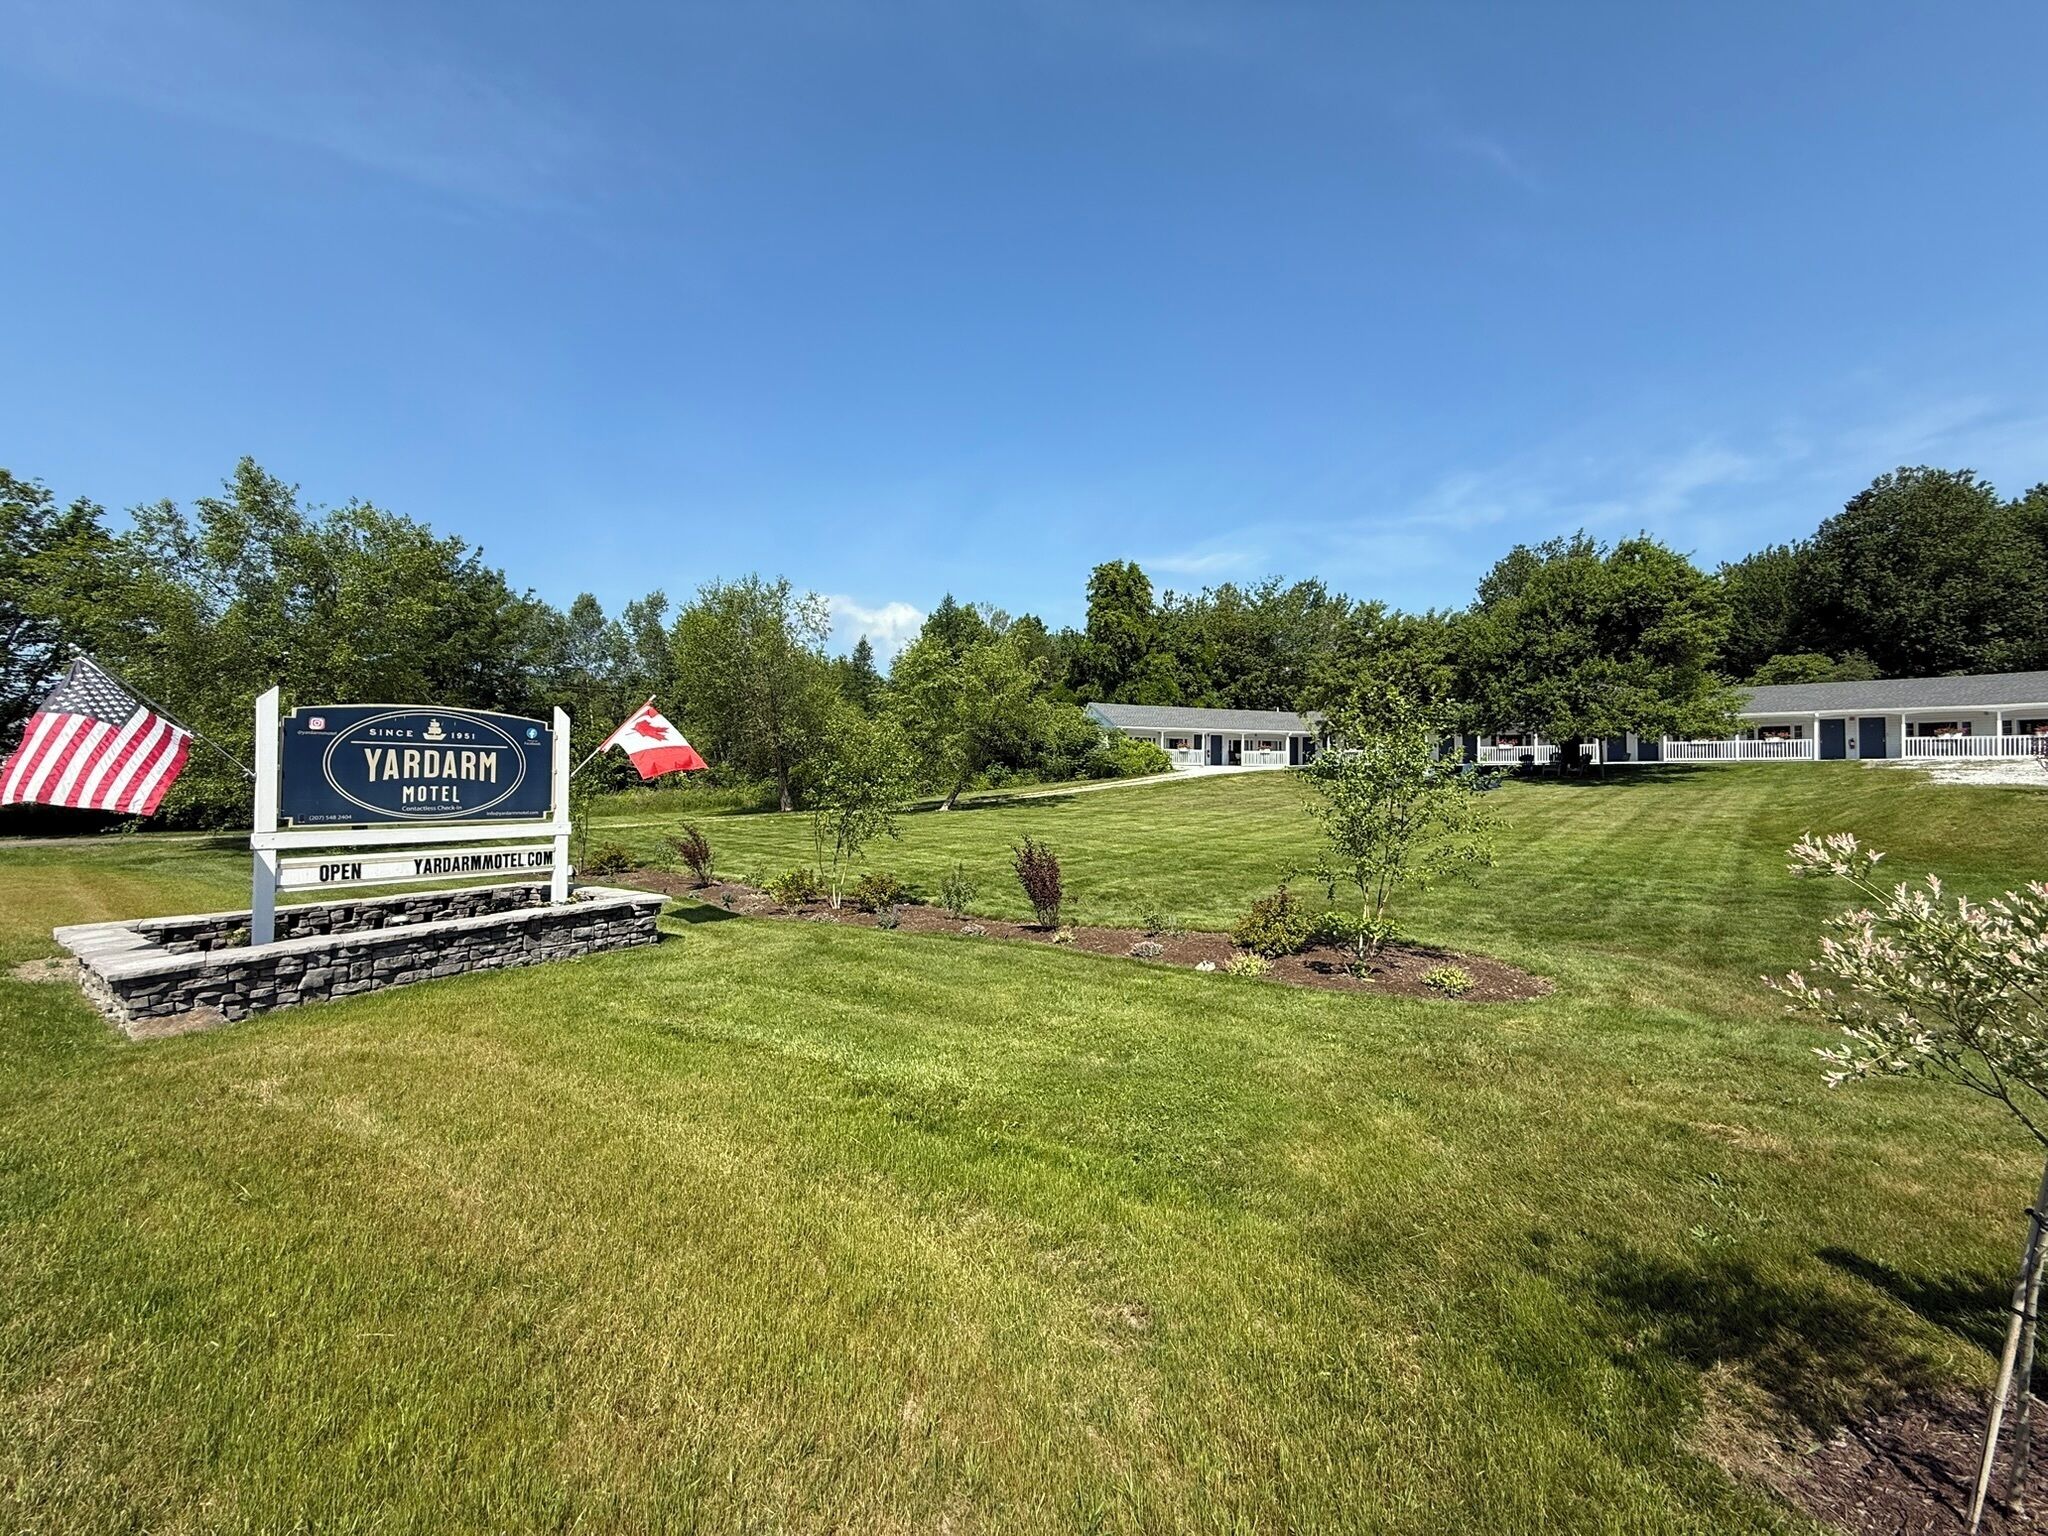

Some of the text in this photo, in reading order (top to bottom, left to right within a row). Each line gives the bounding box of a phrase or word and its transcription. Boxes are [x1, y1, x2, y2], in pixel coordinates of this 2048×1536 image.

[369, 728, 476, 740] SINCE 1951
[364, 748, 497, 784] YARDARM
[402, 785, 460, 804] MOTEL
[319, 851, 553, 882] OPEN YARDARMMOTEL.COM
